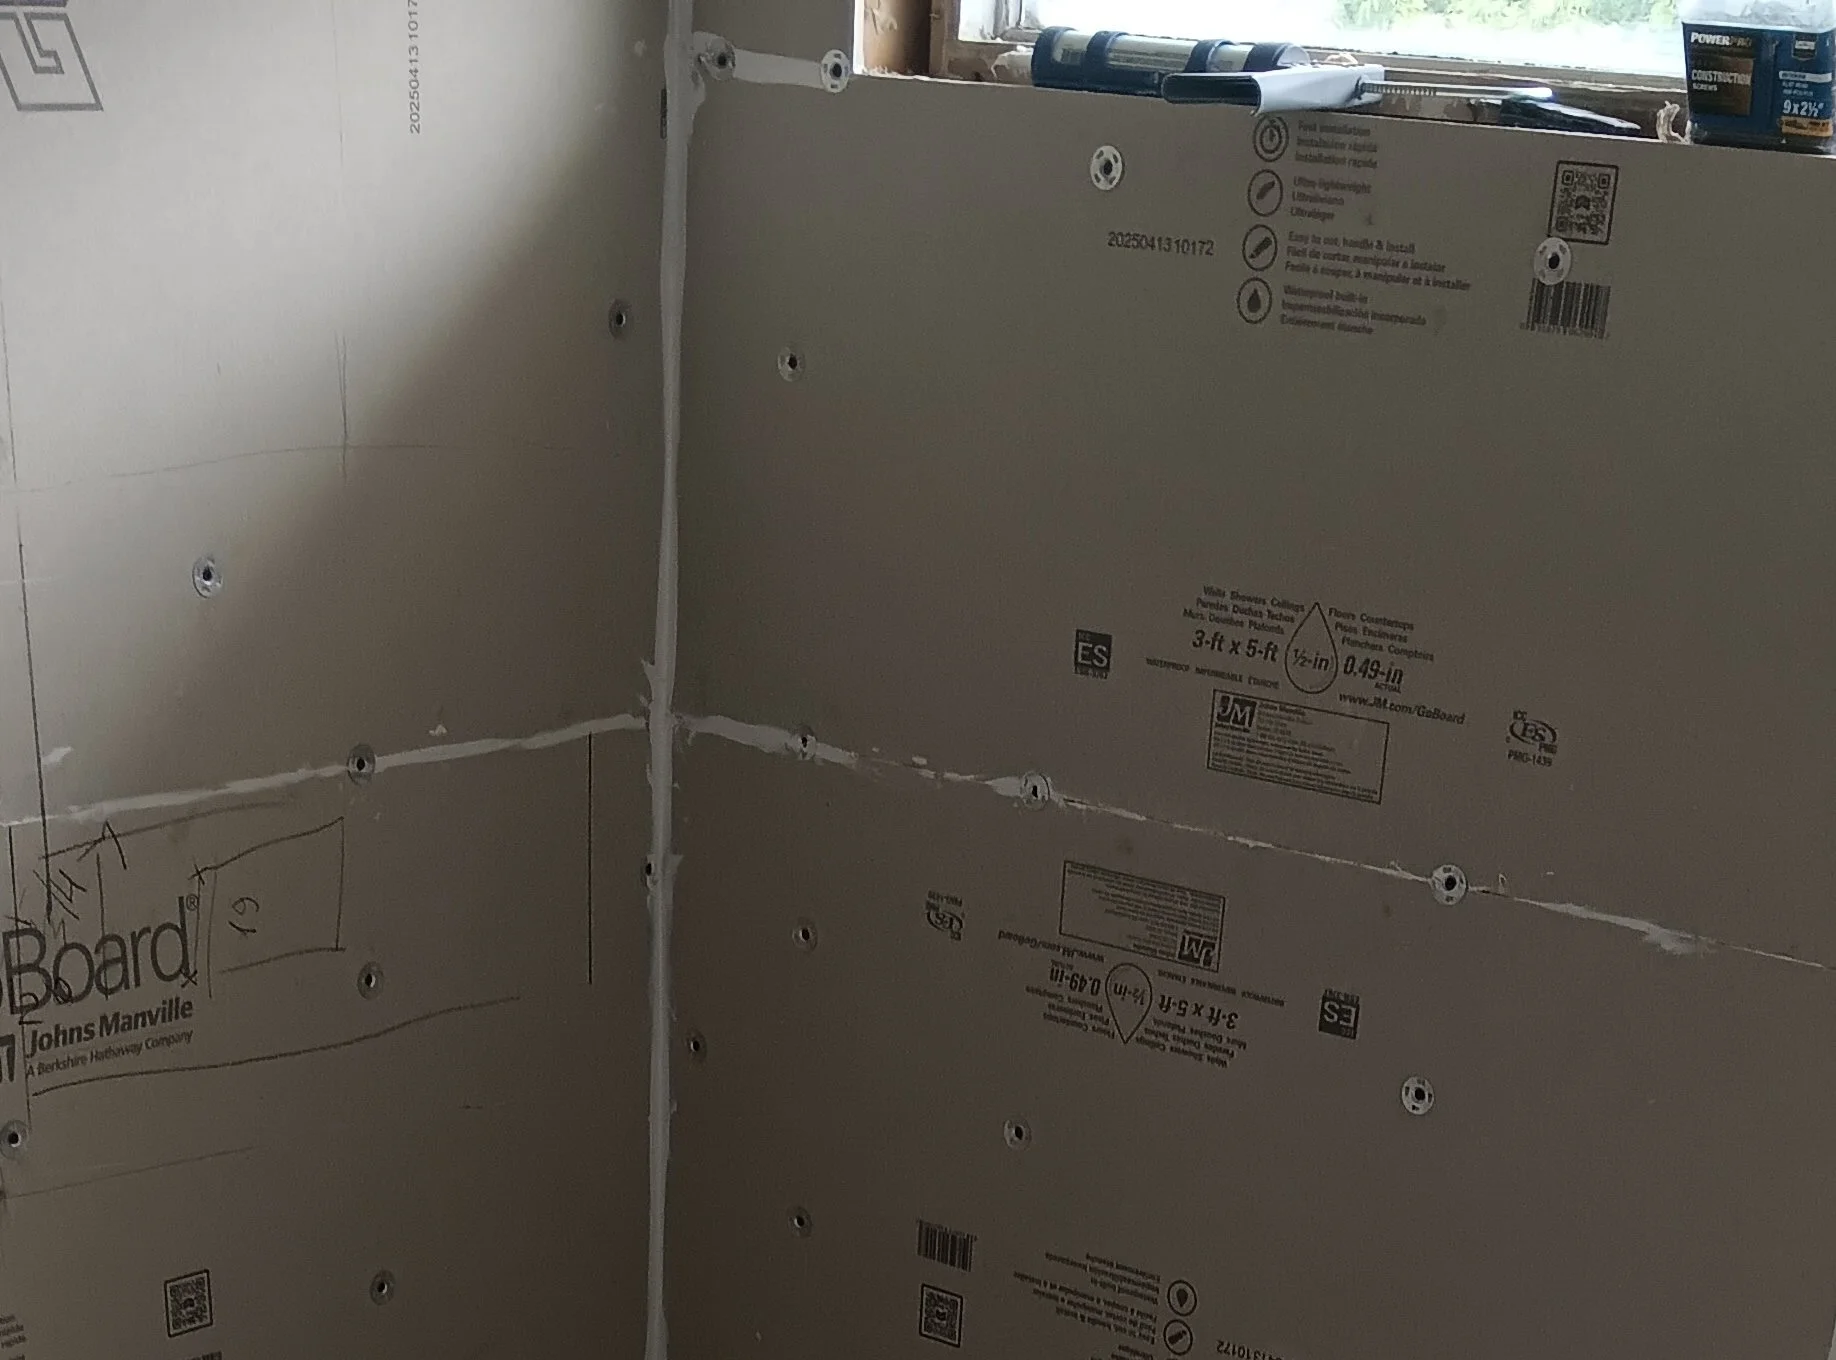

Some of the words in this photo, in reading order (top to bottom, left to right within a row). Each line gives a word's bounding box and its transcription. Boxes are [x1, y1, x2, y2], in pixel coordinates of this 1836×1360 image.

[1691, 69, 1752, 86] CONSTRUCTION
[1077, 641, 1108, 668] ES
[1192, 629, 1225, 652] 3-ft
[1230, 640, 1241, 655] x
[1245, 638, 1279, 662] 5-ft
[1292, 648, 1330, 671] ½-in
[1343, 655, 1404, 685] 0.49-in
[1216, 695, 1258, 728] JM
[1339, 693, 1466, 725] www.JM.com/GoBoard
[1177, 935, 1216, 967] JM
[1049, 968, 1101, 996] 0.49-in
[1159, 995, 1189, 1017] 5-ft
[1192, 1003, 1204, 1017] x
[1208, 1007, 1239, 1030] 3-ft
[1323, 1000, 1356, 1028] ES
[25, 1022, 96, 1059] Johns
[99, 997, 193, 1038] Manville
[26, 1062, 36, 1079] A
[38, 1052, 87, 1076] Berkshire
[90, 1041, 141, 1064] Hathaway
[144, 1029, 193, 1050] Company
